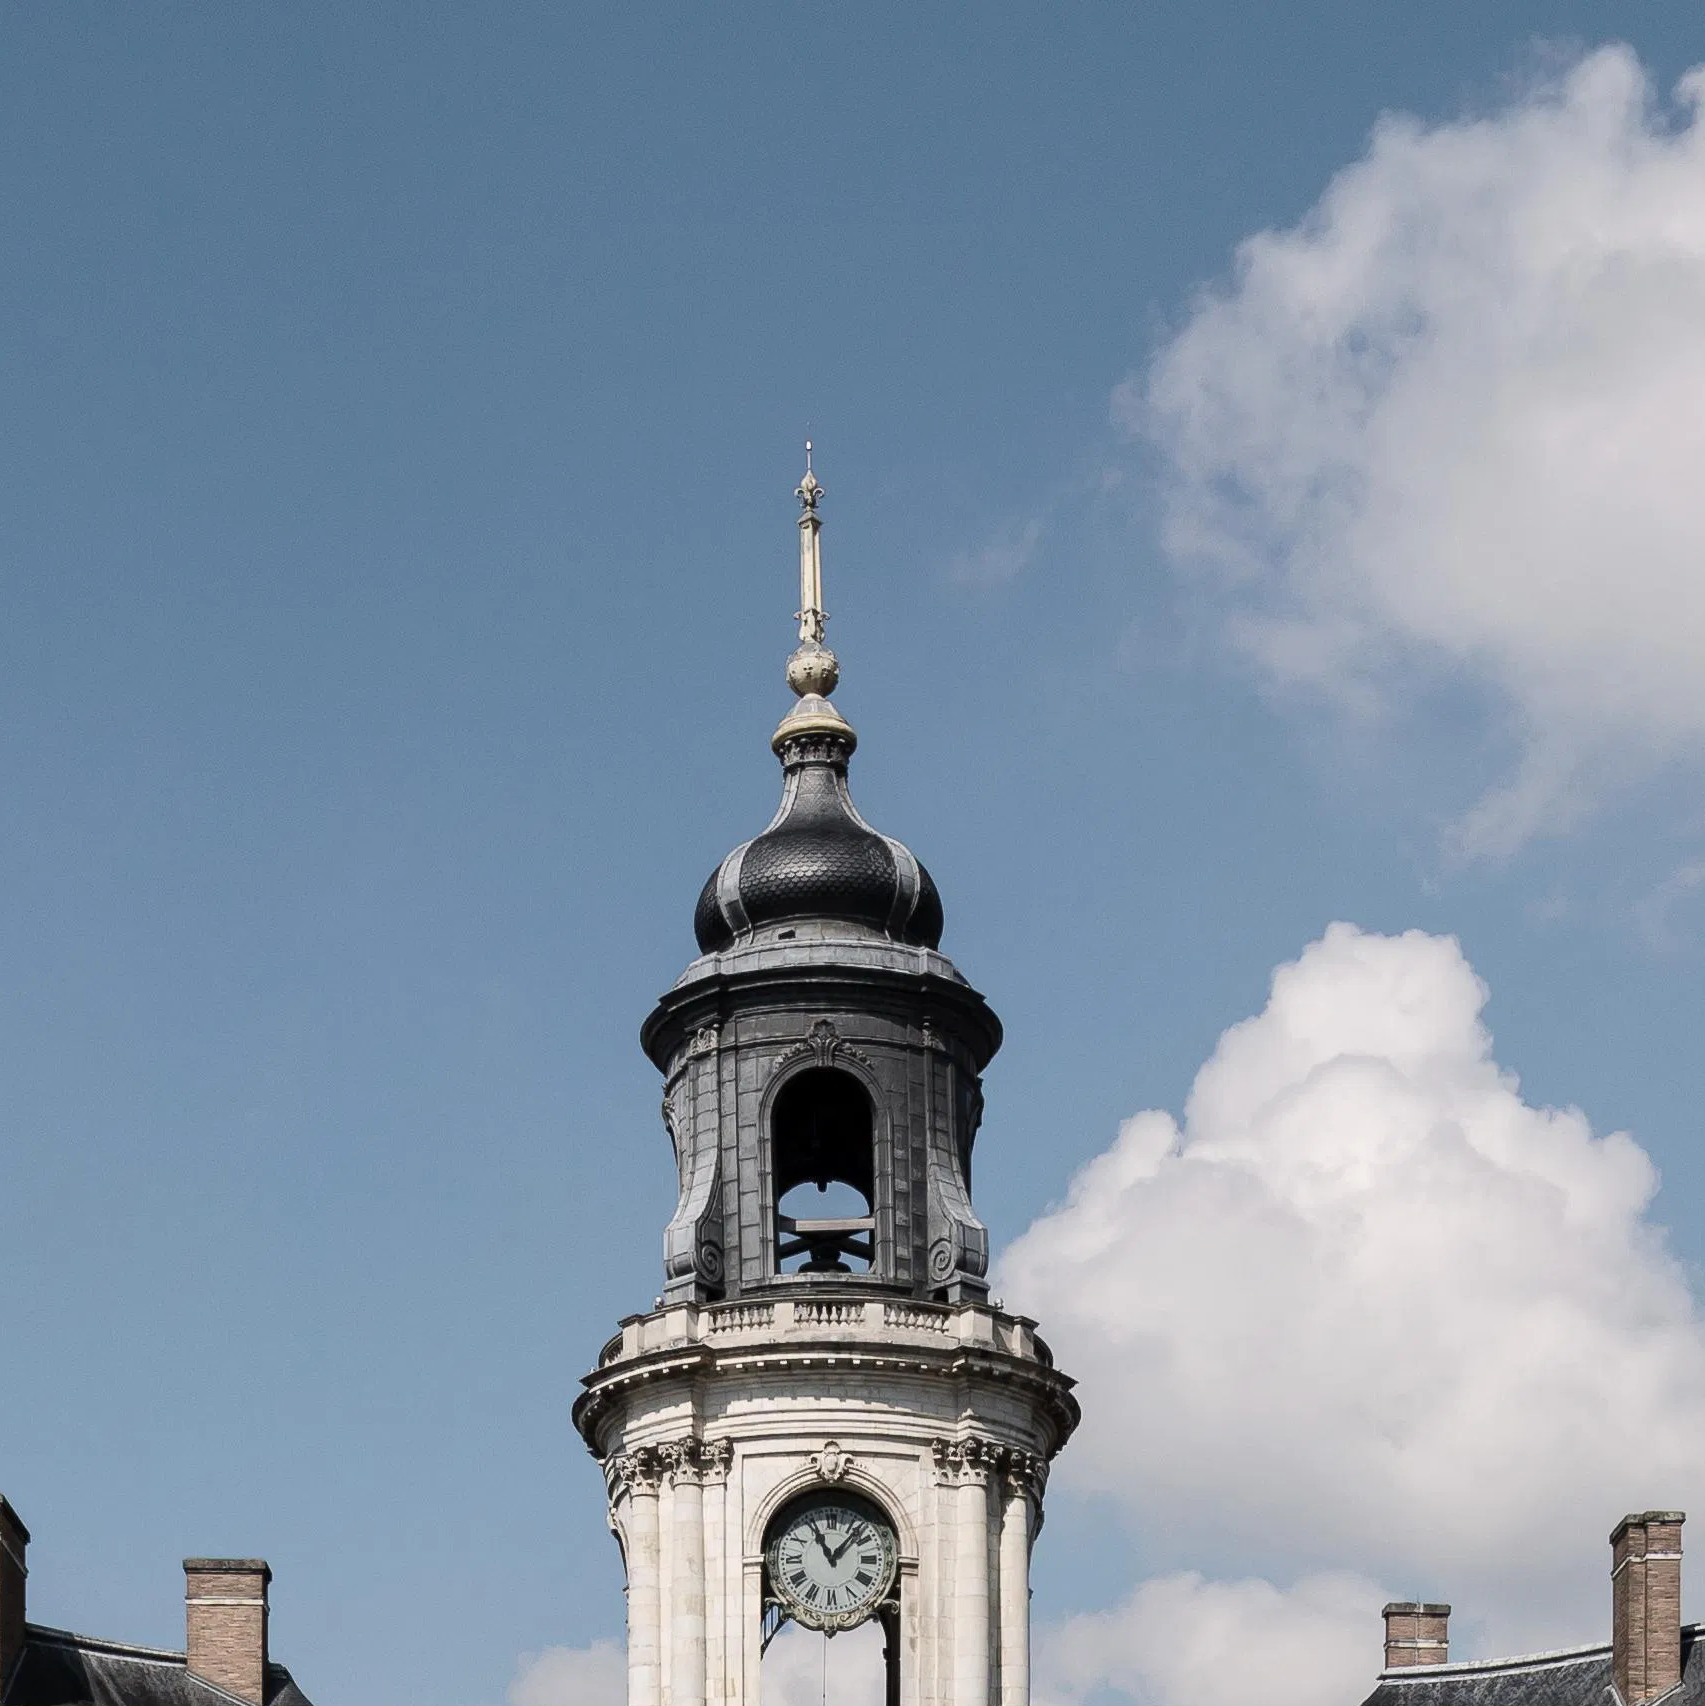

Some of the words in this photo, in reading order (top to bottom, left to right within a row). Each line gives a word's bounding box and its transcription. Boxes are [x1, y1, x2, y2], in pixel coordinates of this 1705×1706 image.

[826, 1513, 837, 1530] XII
[790, 1532, 808, 1547] X
[786, 1553, 802, 1564] IX
[861, 1555, 877, 1564] III
[827, 1589, 837, 1606] VI
[845, 1585, 858, 1602] V
